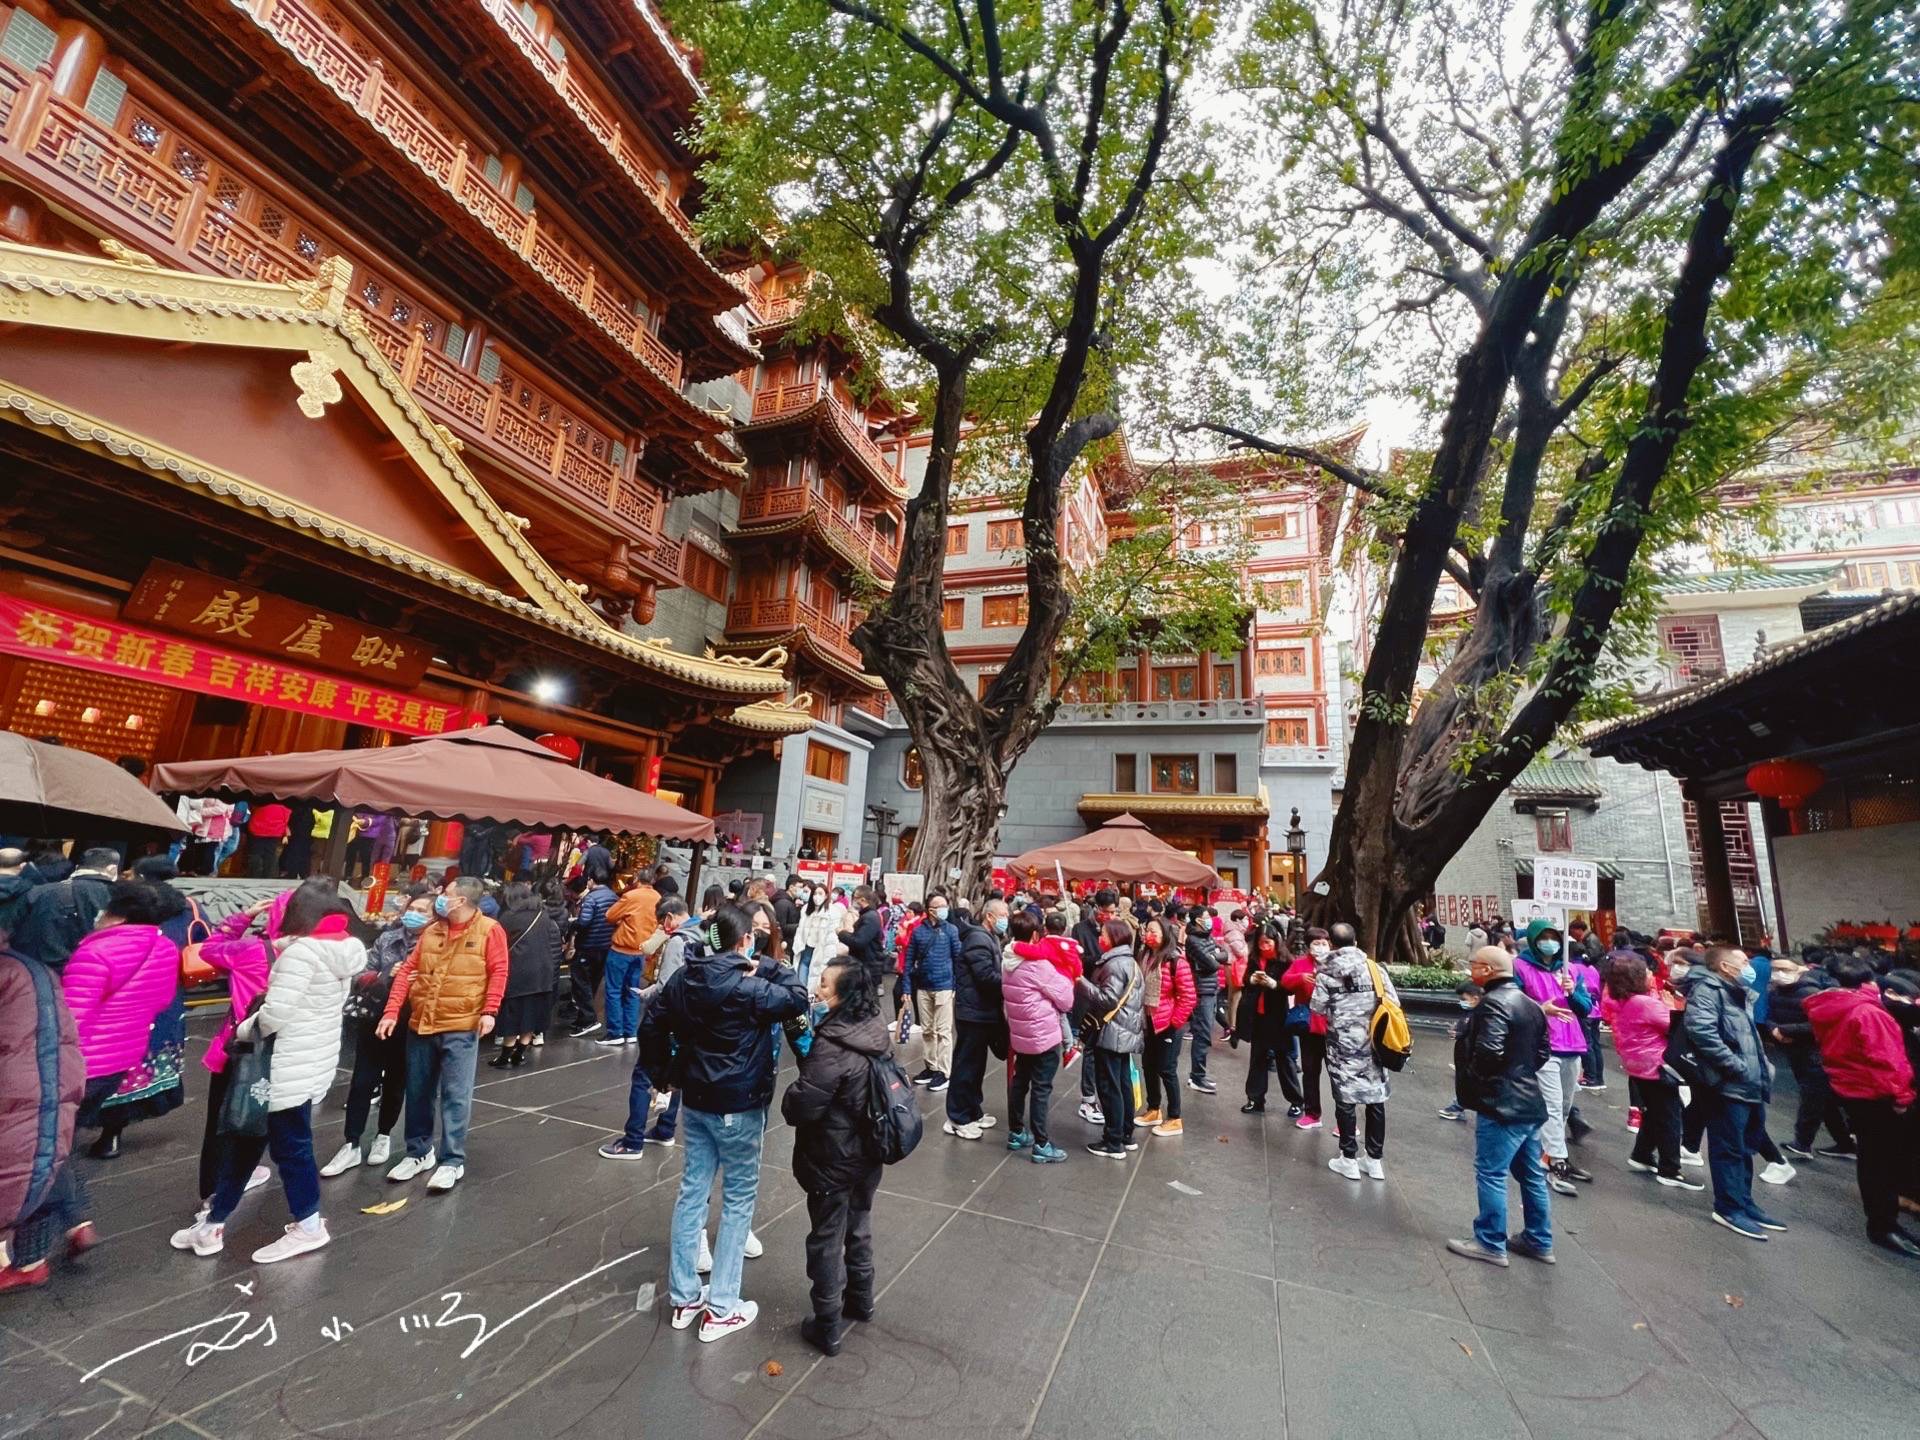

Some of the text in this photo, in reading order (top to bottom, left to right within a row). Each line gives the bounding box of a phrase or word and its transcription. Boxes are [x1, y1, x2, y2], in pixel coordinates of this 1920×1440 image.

[16, 609, 447, 733] 恭贺新春 吉祥安康 平安是福
[1553, 867, 1591, 879] 请戴好口罩
